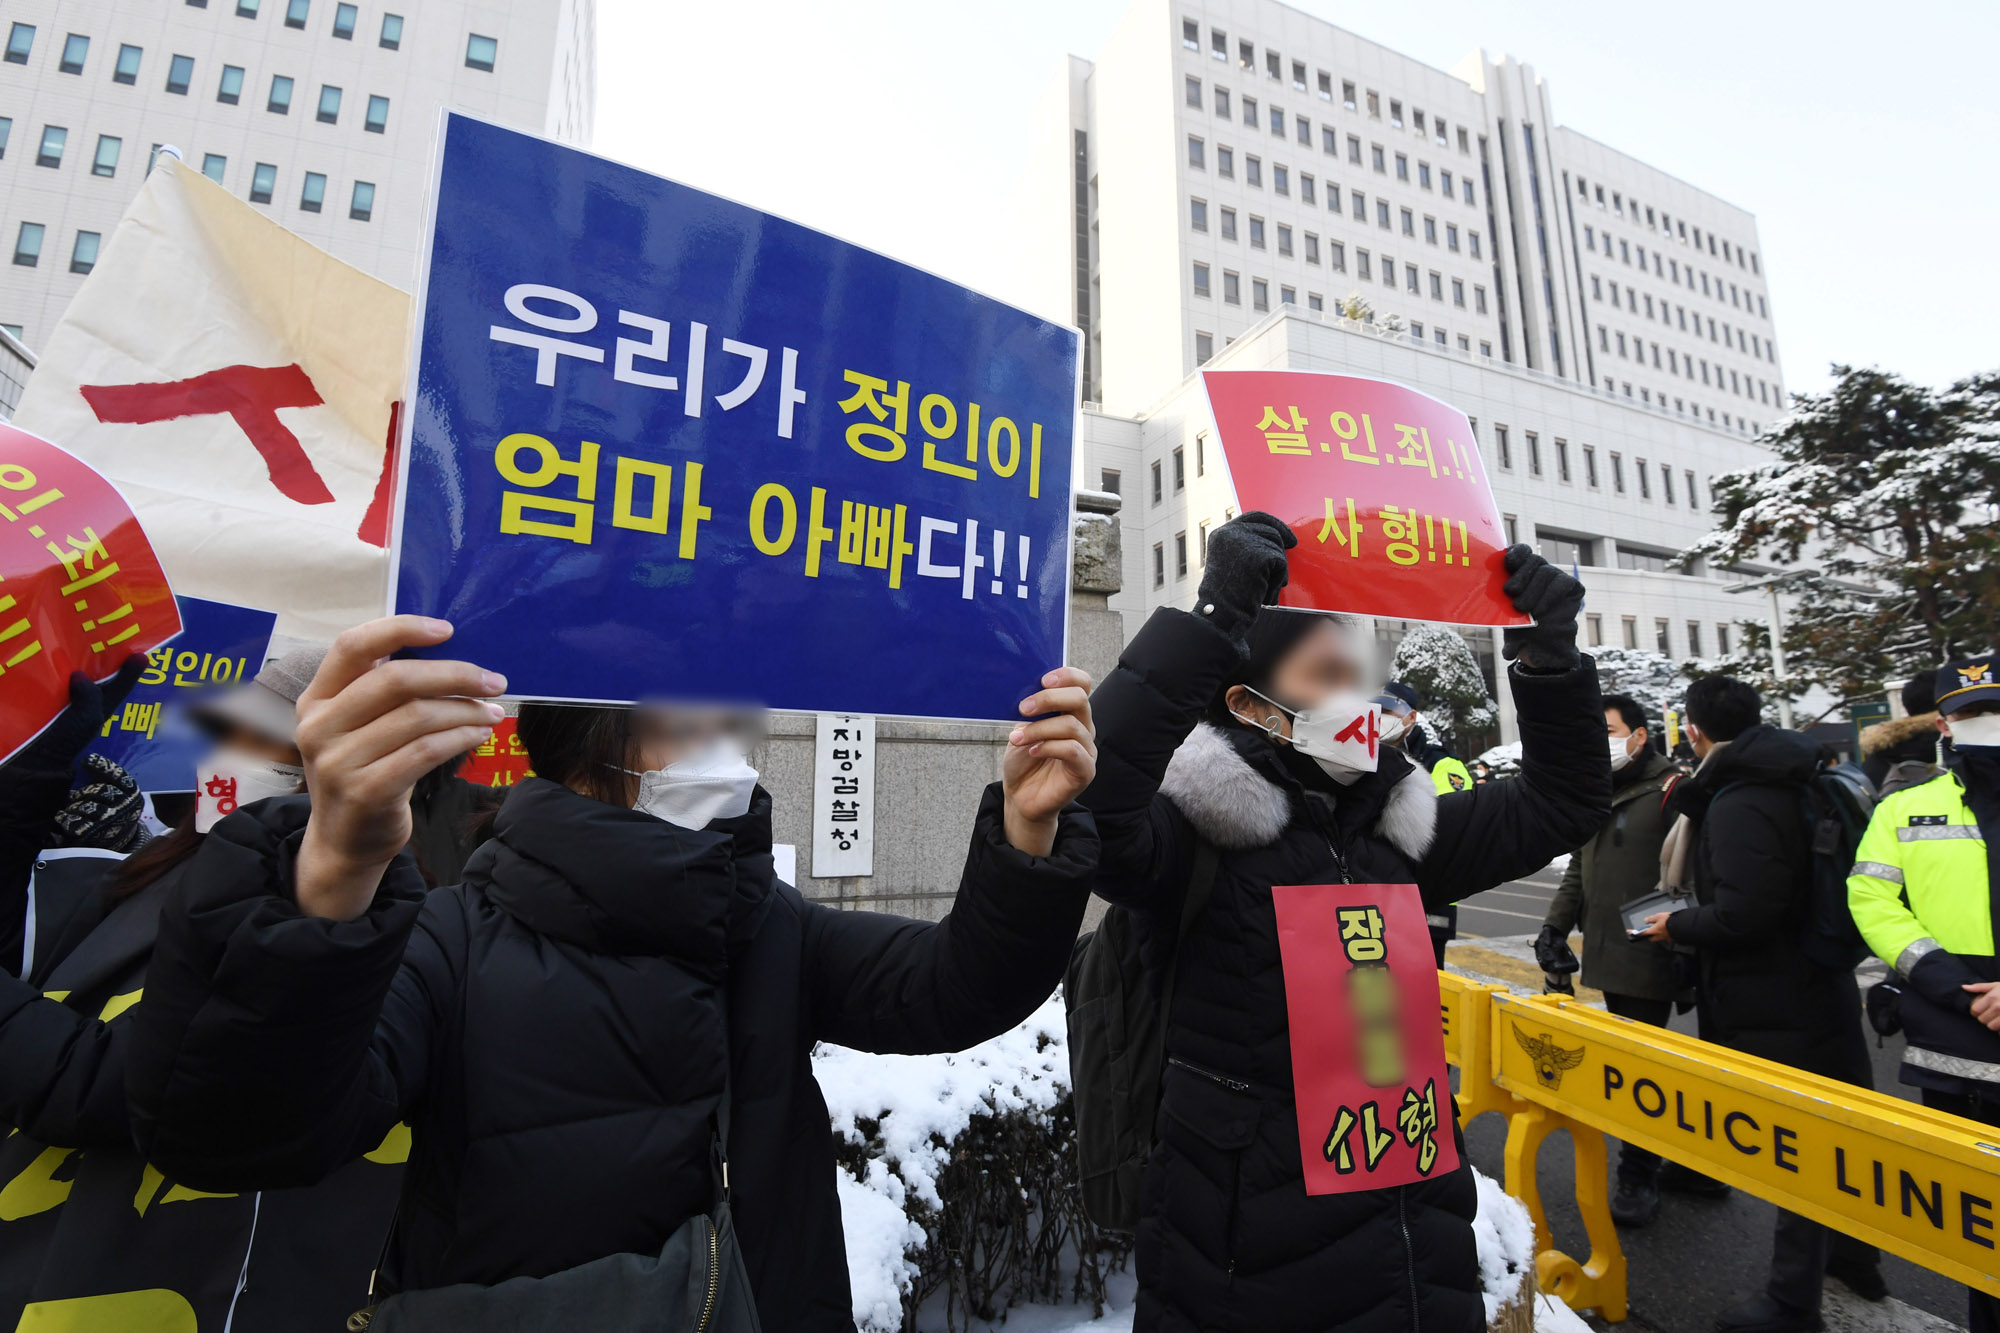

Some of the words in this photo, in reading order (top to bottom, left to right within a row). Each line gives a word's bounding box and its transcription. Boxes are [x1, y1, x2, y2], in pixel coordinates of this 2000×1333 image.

[489, 283, 806, 439] 우리가
[837, 369, 1043, 499] 정인이
[1256, 405, 1477, 484] 살.인.죄.!!
[494, 433, 712, 560] 엄마
[748, 482, 1031, 600] 아빠다!!
[1317, 497, 1363, 558] 사
[1378, 504, 1471, 567] 형!!!
[138, 647, 246, 687] 정인이
[101, 702, 161, 740] 빠
[1333, 709, 1381, 760] 사
[196, 774, 238, 815] 형
[831, 716, 862, 851] 지방검찰청
[1324, 1078, 1438, 1175] 사형
[1604, 1064, 1799, 1174] POLICE
[1835, 1146, 1995, 1250] LINE
